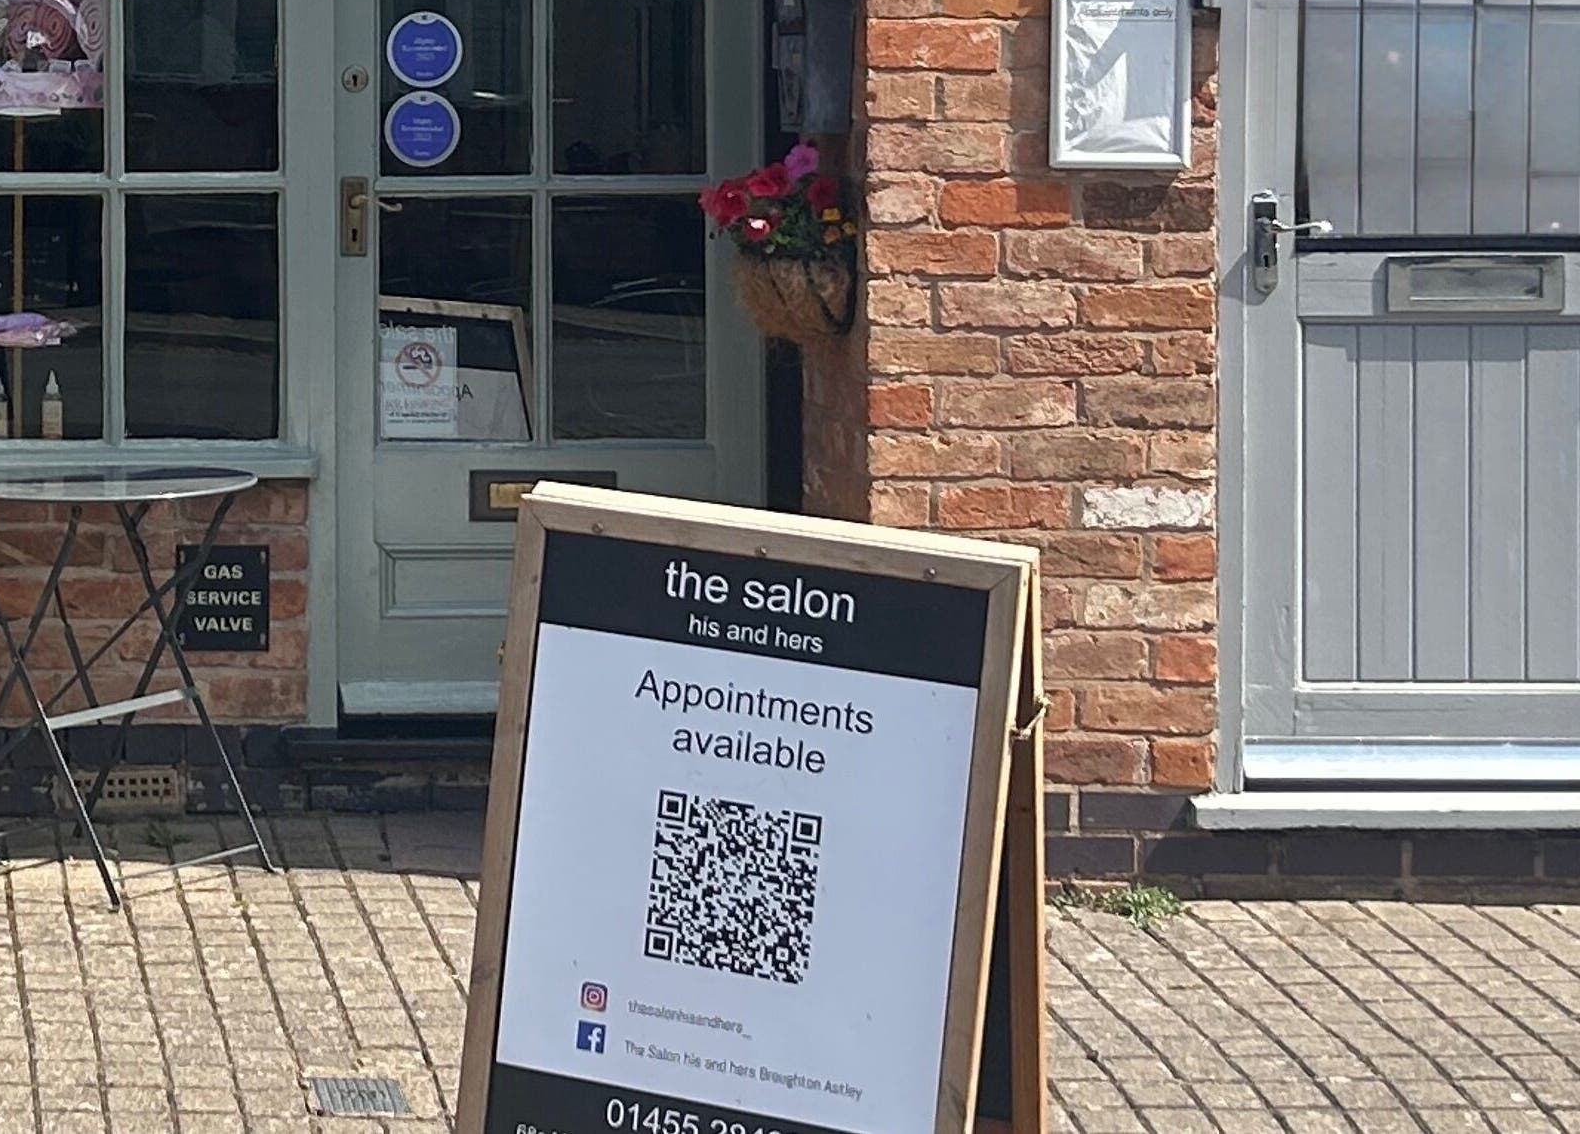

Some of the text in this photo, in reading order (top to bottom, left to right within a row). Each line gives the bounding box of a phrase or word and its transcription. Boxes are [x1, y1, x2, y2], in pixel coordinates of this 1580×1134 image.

[203, 564, 244, 580] GAS
[665, 561, 855, 623] the salon
[186, 590, 262, 606] SERVICE
[194, 616, 254, 632] VALVE
[688, 613, 823, 653] his and hers
[634, 669, 874, 734] Appointments
[672, 728, 826, 773] available
[625, 1039, 863, 1102] The Salon his and hers Broughton Astley
[606, 1098, 700, 1134] 01455
